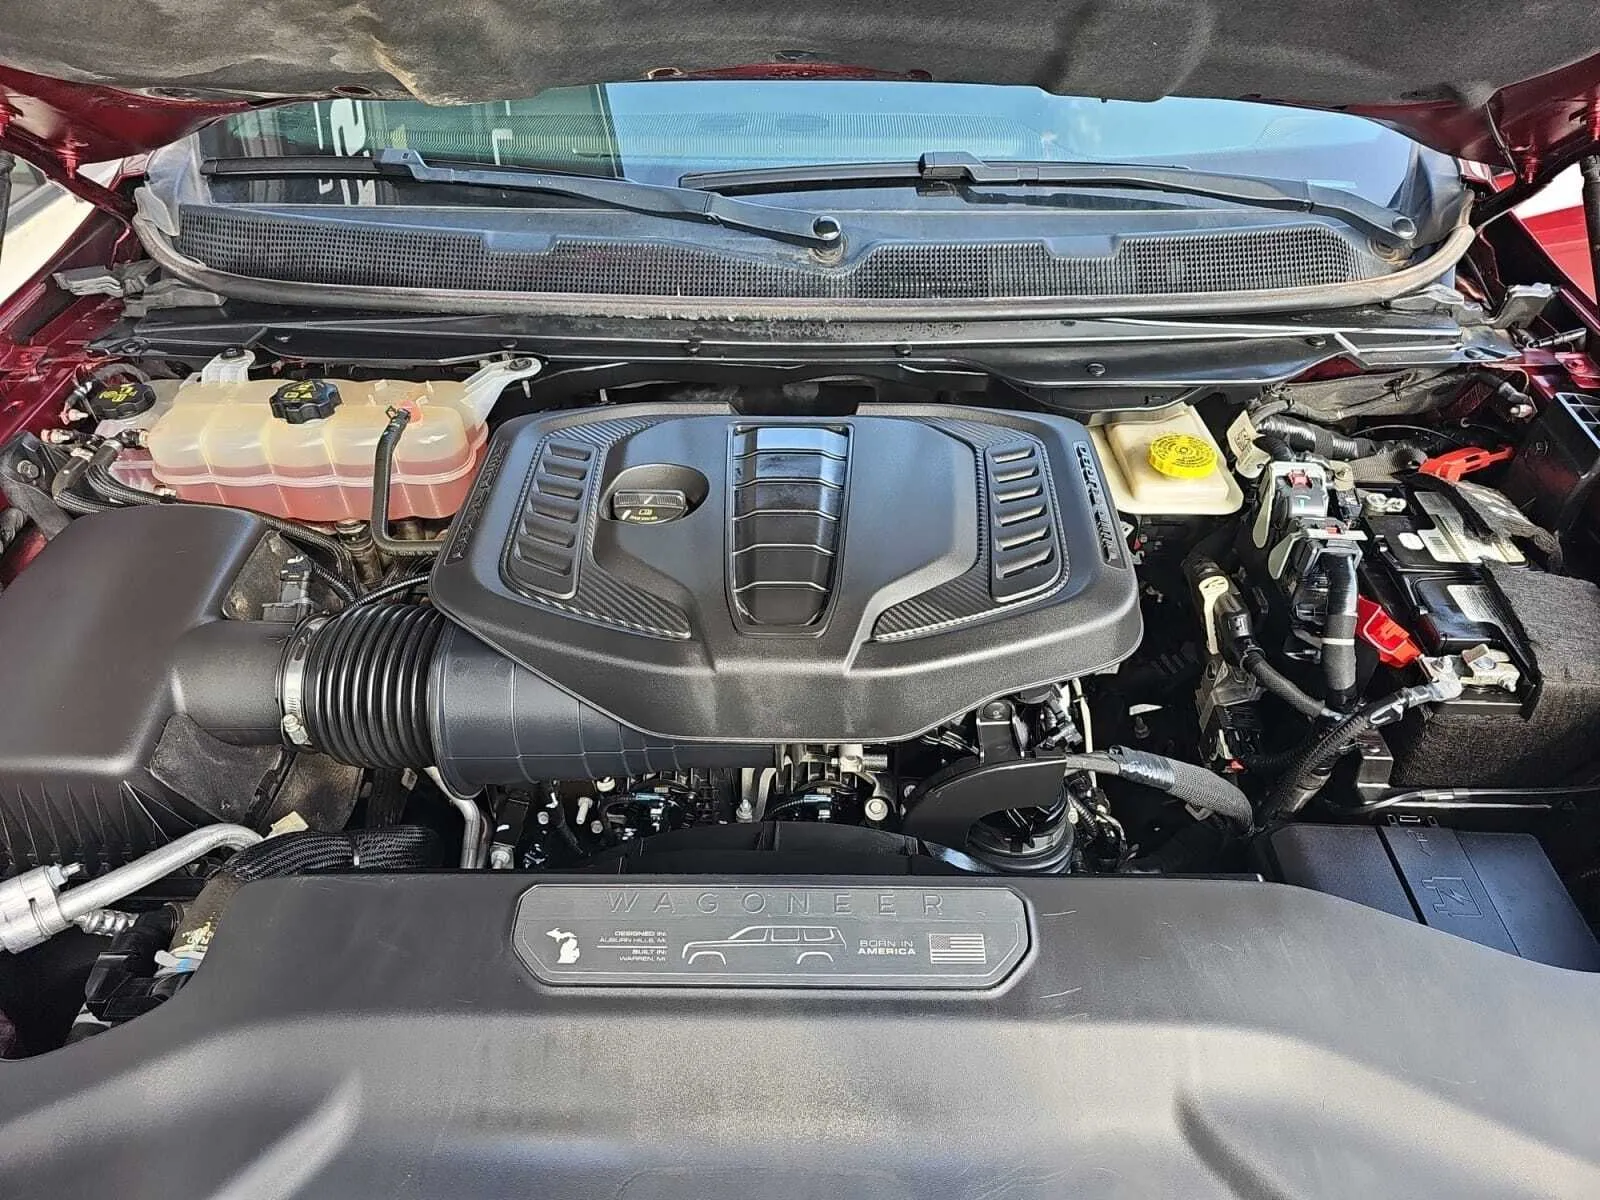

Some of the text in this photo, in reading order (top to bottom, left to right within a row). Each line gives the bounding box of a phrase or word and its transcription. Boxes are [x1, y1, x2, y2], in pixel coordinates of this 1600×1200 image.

[607, 892, 944, 914] WAGONEER
[859, 939, 913, 948] BORN IN
[857, 947, 916, 955] AMERICA
